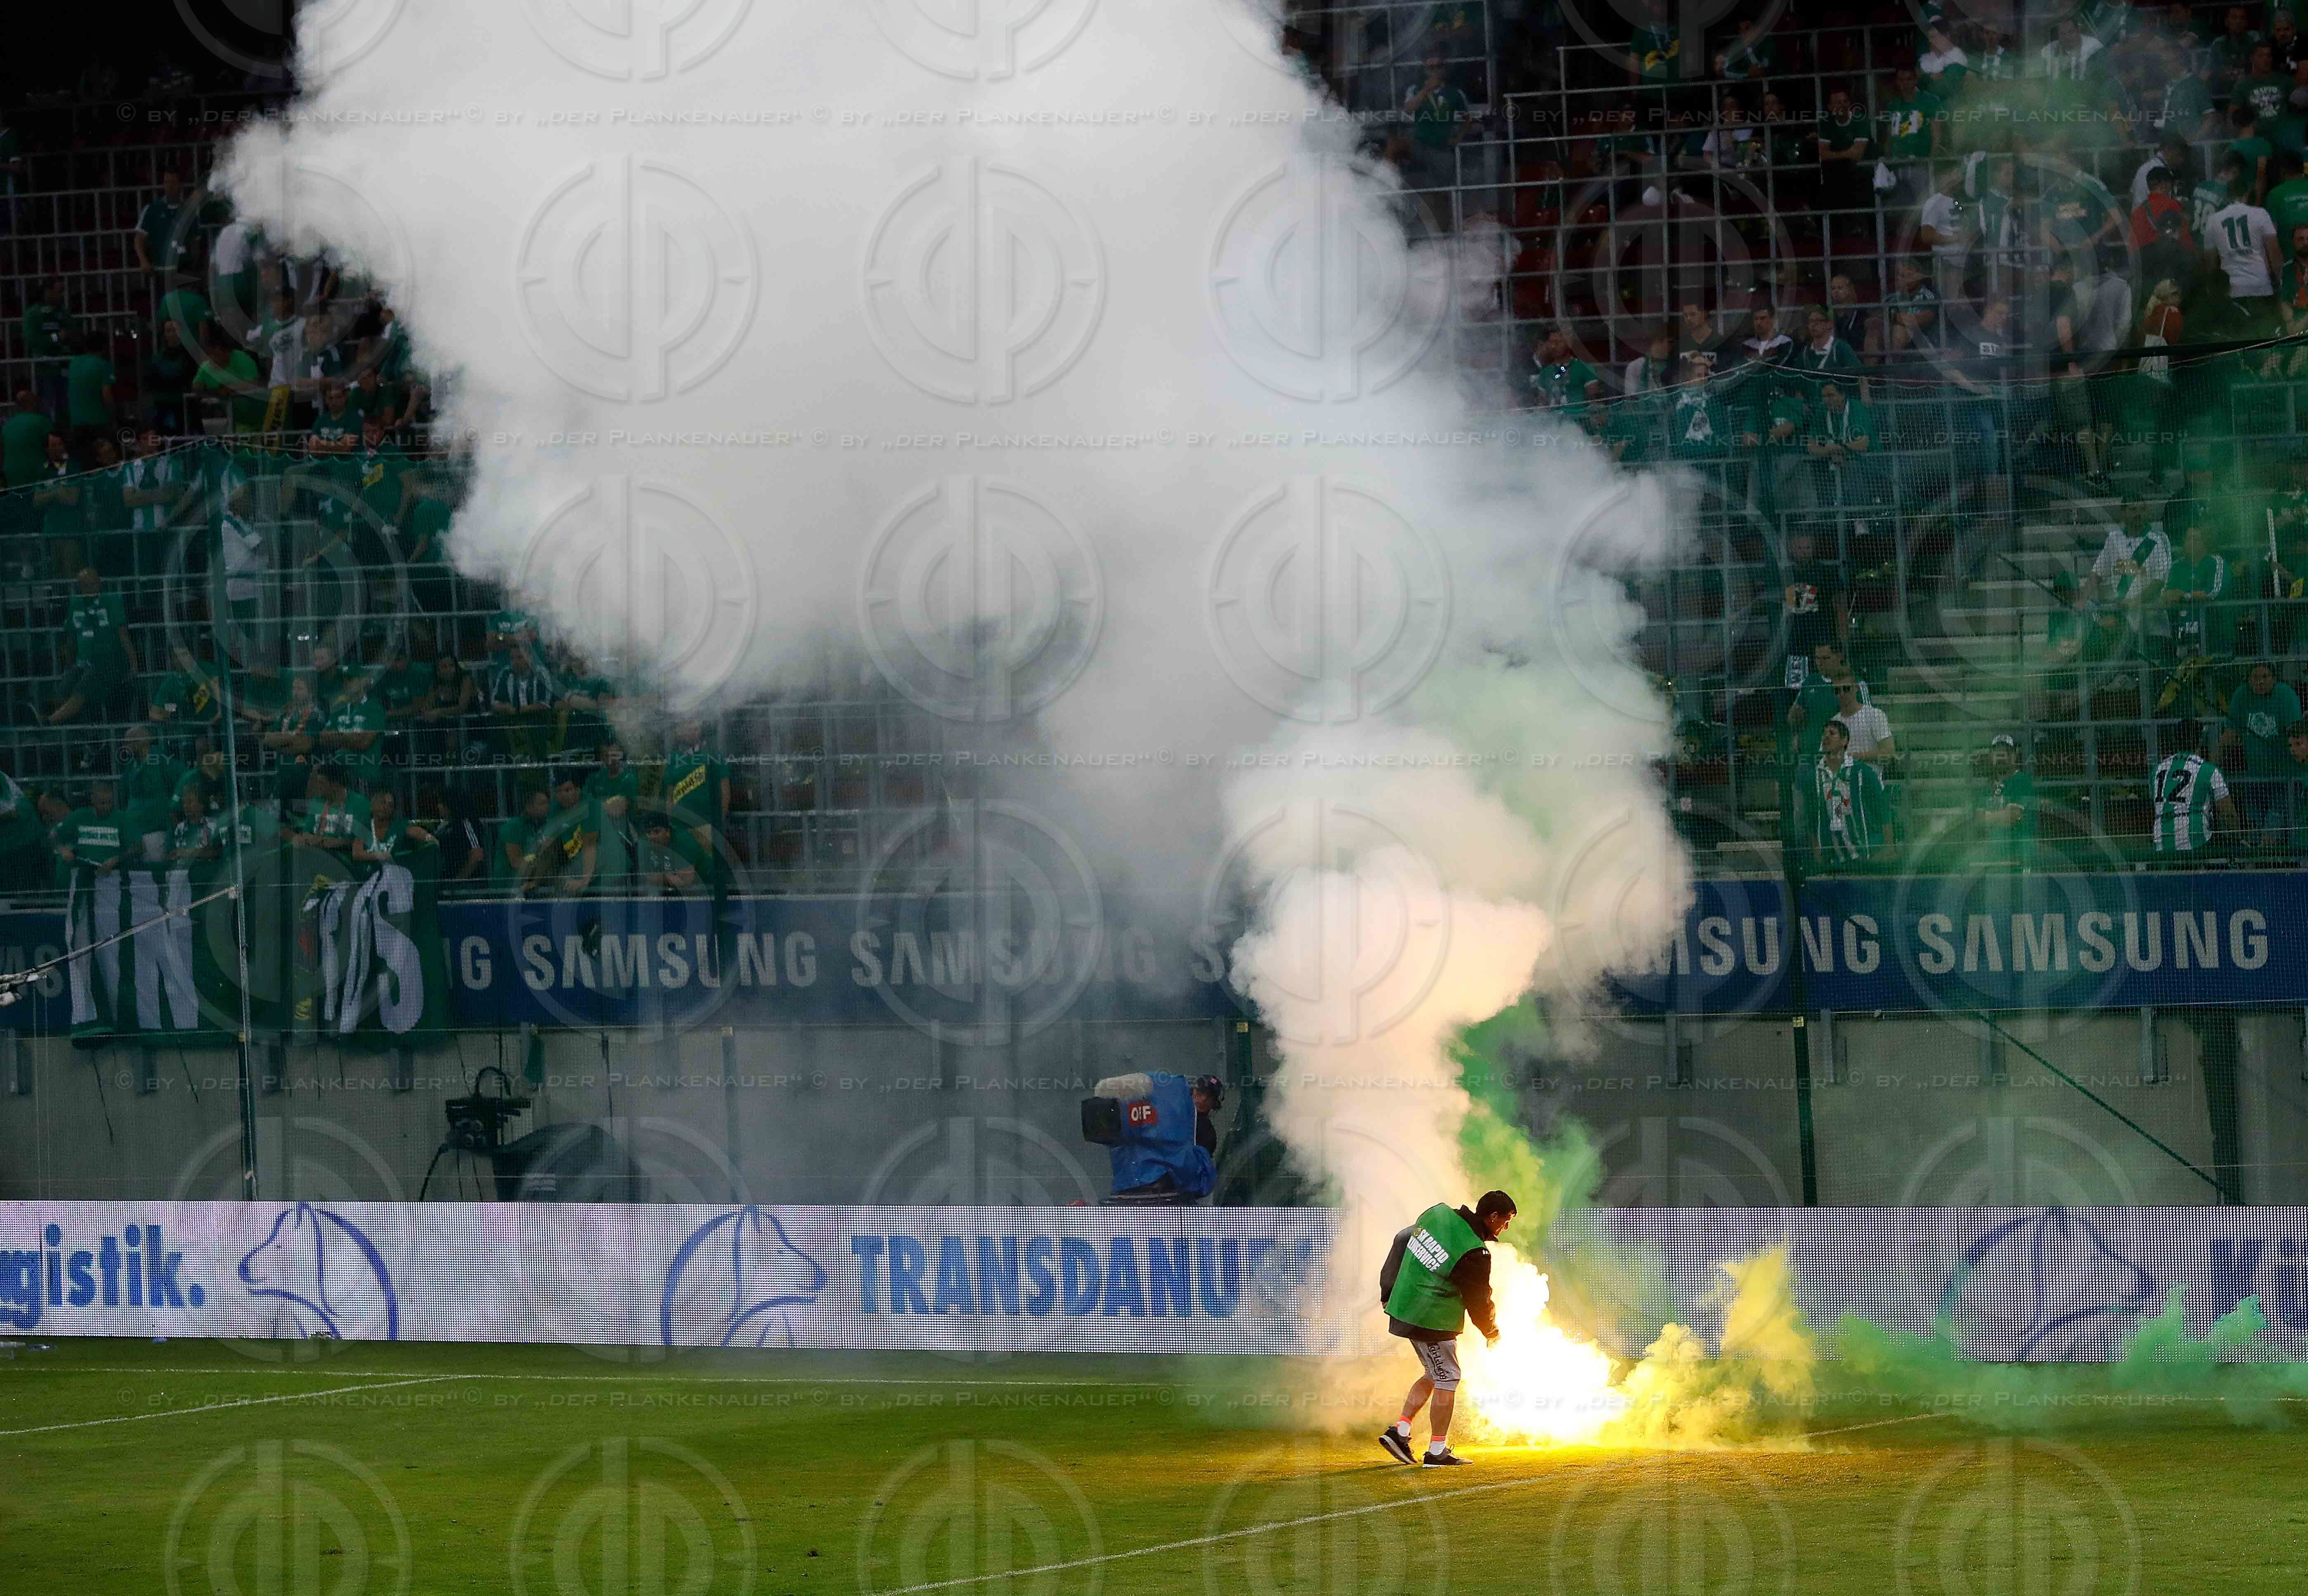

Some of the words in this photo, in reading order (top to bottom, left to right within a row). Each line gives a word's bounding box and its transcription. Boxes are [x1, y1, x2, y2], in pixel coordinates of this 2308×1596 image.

[2221, 215, 2252, 248] 11
[2155, 769, 2192, 803] 12
[1917, 909, 2269, 975] SAMSUNG
[522, 931, 818, 991] SAMSUNG
[1417, 1229, 1430, 1242] SK
[1422, 1236, 1449, 1264] RAPID
[0, 1223, 206, 1329] gistik.
